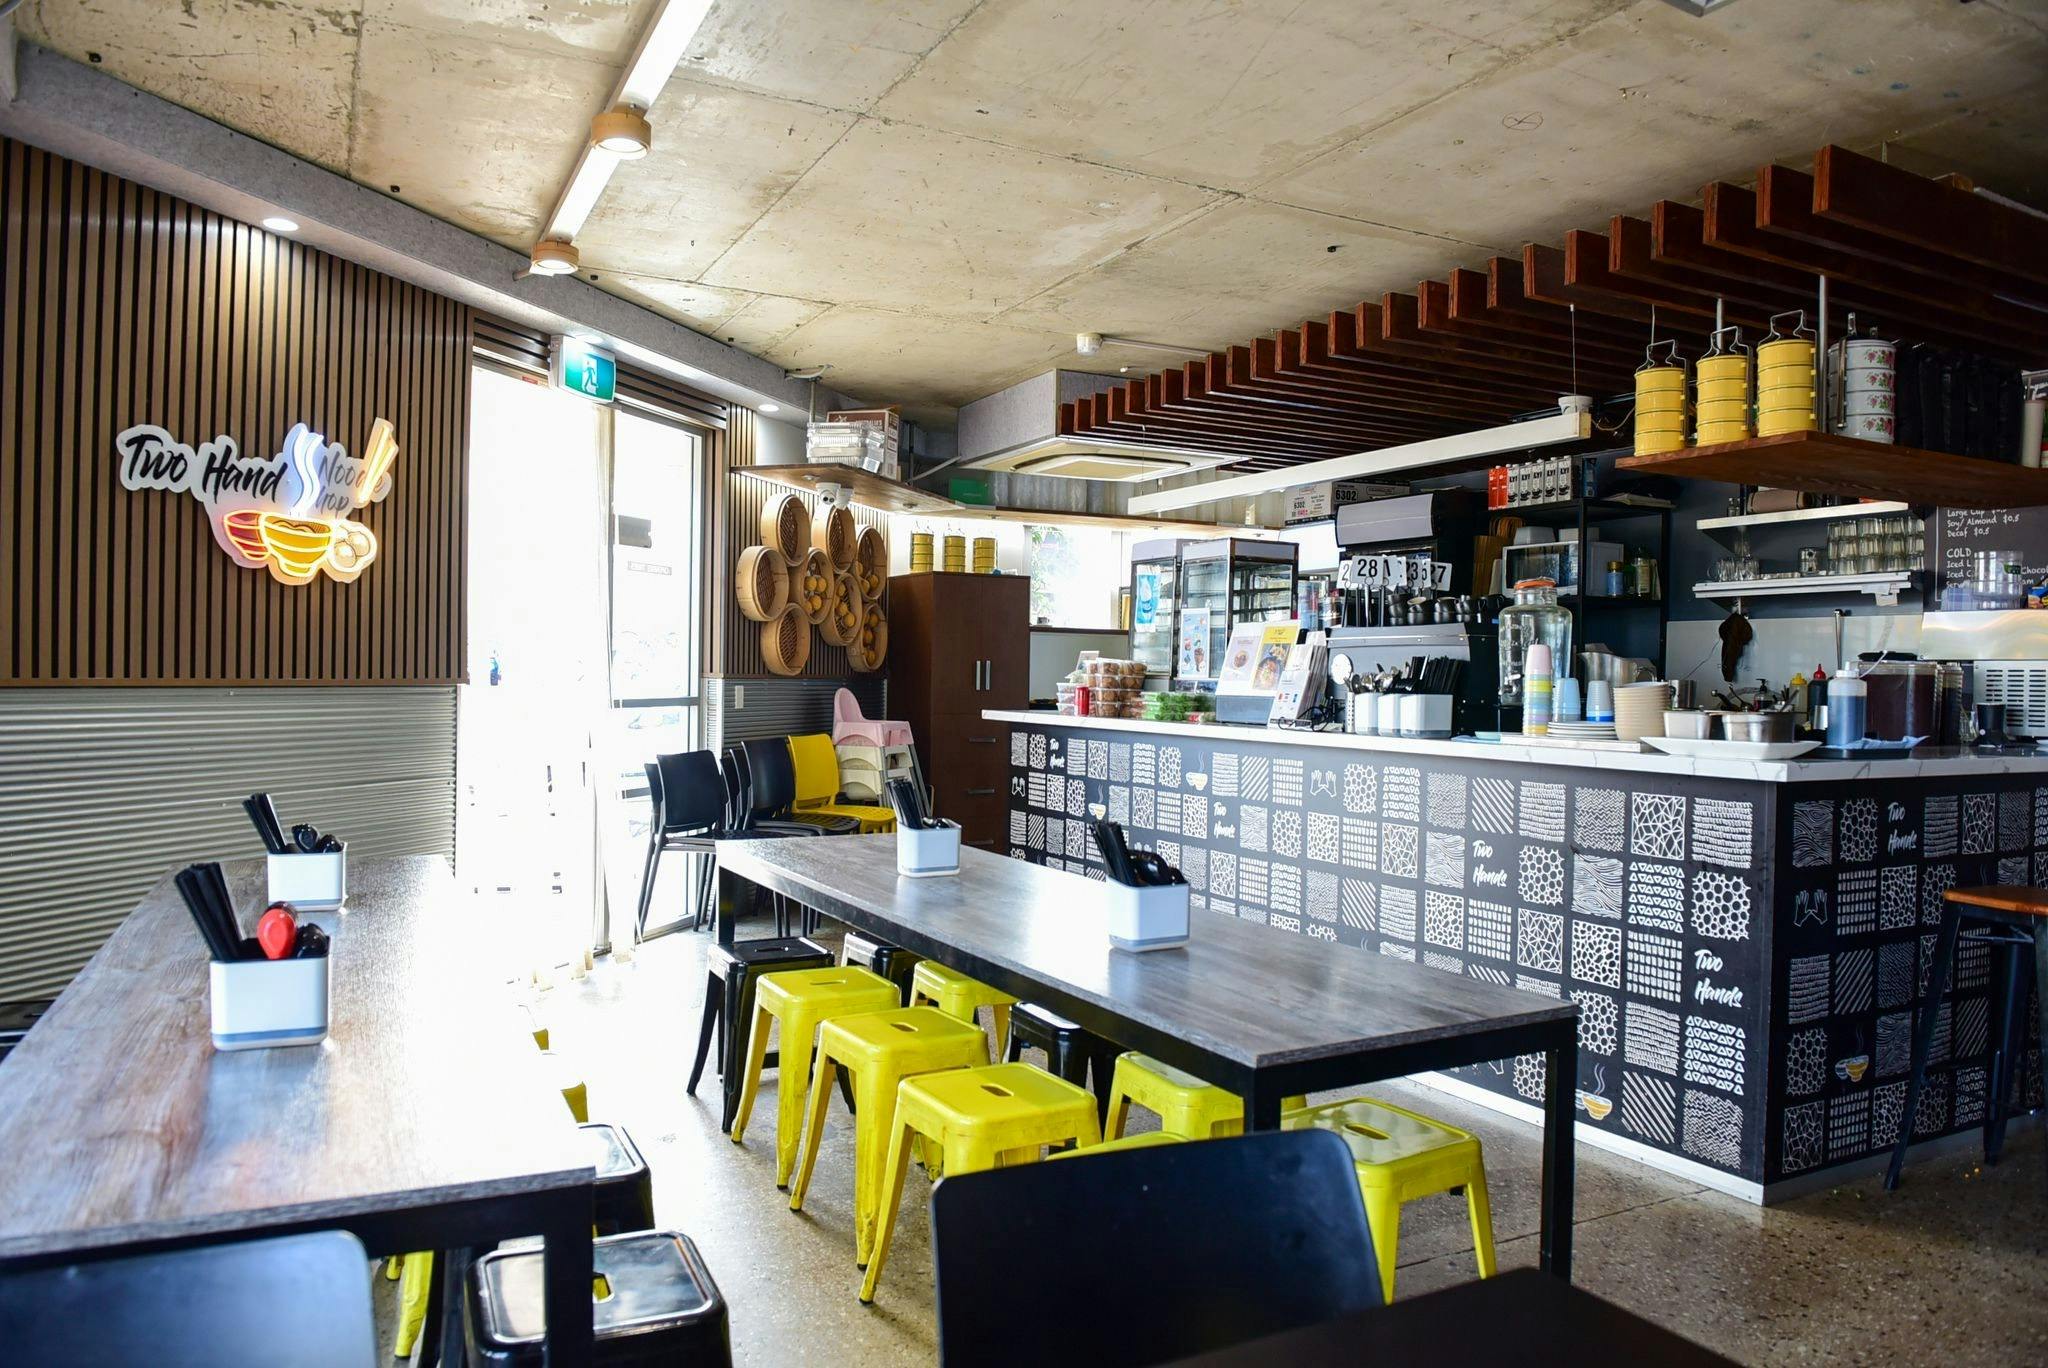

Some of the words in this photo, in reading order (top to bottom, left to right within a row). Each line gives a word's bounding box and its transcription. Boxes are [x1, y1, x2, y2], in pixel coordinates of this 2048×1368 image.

[126, 434, 188, 483] Two
[1335, 489, 1357, 501] 6302
[1947, 509, 1968, 519] Large
[1967, 515, 1997, 526] Almond
[2003, 514, 2020, 524] $0.5
[1947, 527, 1968, 538] Decaf
[1946, 547, 1972, 558] COLD
[1357, 559, 1378, 578] 28
[1947, 559, 1964, 568] Iced
[1946, 569, 1964, 578] Iced
[1888, 801, 1906, 823] Two
[1472, 839, 1493, 858] Two
[1472, 863, 1508, 888] Hands
[1694, 949, 1723, 972] Two
[1694, 977, 1743, 1008] Hands
